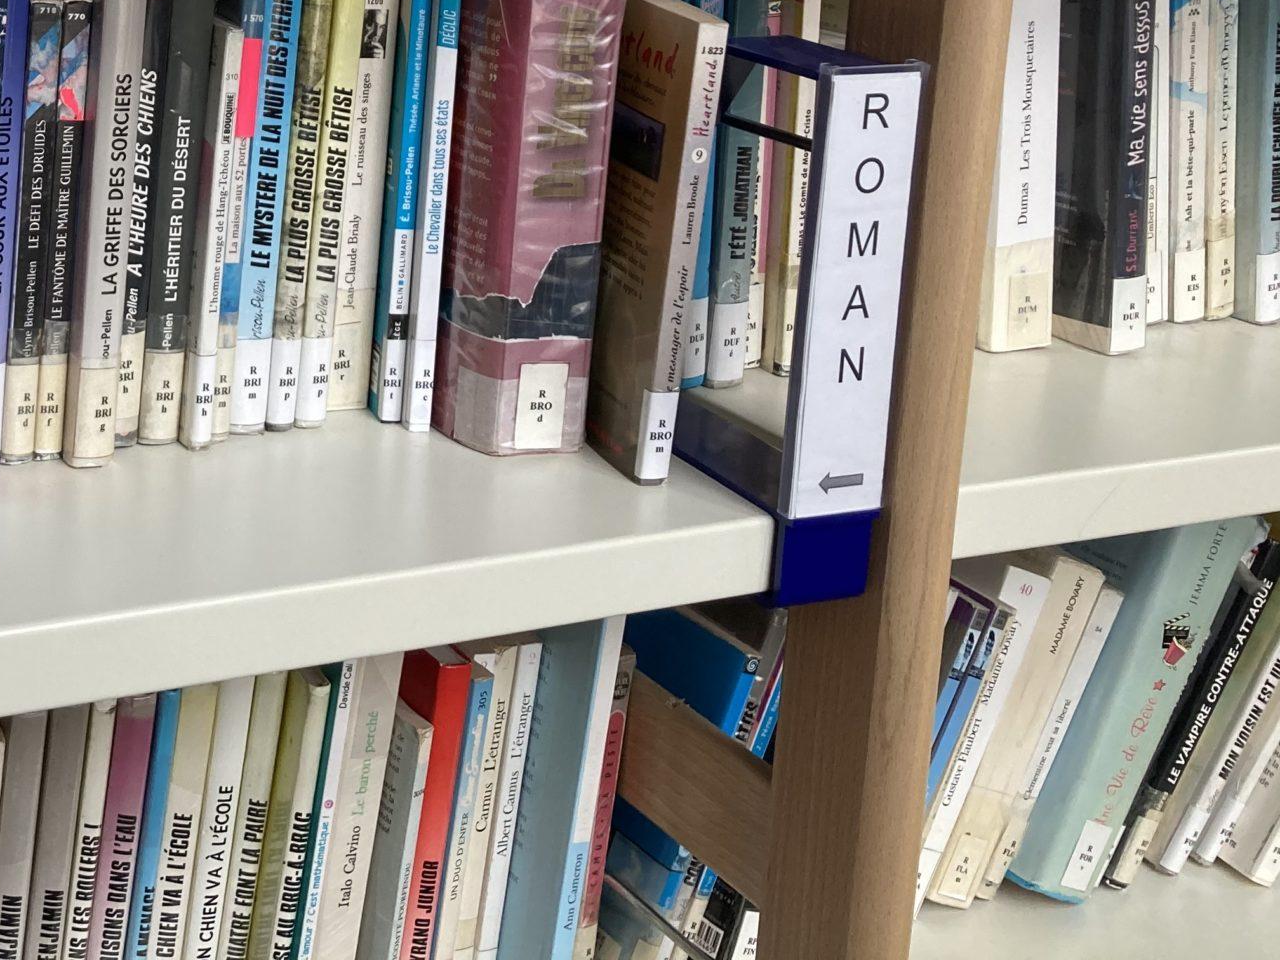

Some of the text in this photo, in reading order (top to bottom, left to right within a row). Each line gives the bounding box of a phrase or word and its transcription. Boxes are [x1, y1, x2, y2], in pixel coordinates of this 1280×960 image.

[1023, 21, 1035, 110] Mousquetaires
[1134, 58, 1148, 96] sens
[692, 63, 718, 138] Heartland
[1021, 114, 1031, 145] Trois
[1132, 103, 1146, 130] vie
[1128, 134, 1145, 166] Ma
[102, 73, 132, 295] LA GRIFFE DES SORCIERS
[316, 87, 353, 283] LA PLUS GROSSE BÊTISE
[732, 146, 753, 224] JONATHAN
[1017, 182, 1029, 227] Dumas
[530, 401, 553, 413] BRO
[1049, 576, 1085, 655] MADAME BOVARY
[1167, 577, 1273, 786] LE VAMPIRE CONTRE-ATTAQUE
[497, 692, 531, 857] Albert Camus L'étranger
[209, 785, 234, 846] L'ÉCOLE
[206, 866, 223, 891] VA
[339, 825, 361, 909] Italo Calvino
[425, 861, 439, 912] JUNIOR
[199, 896, 218, 941] CHIEN
